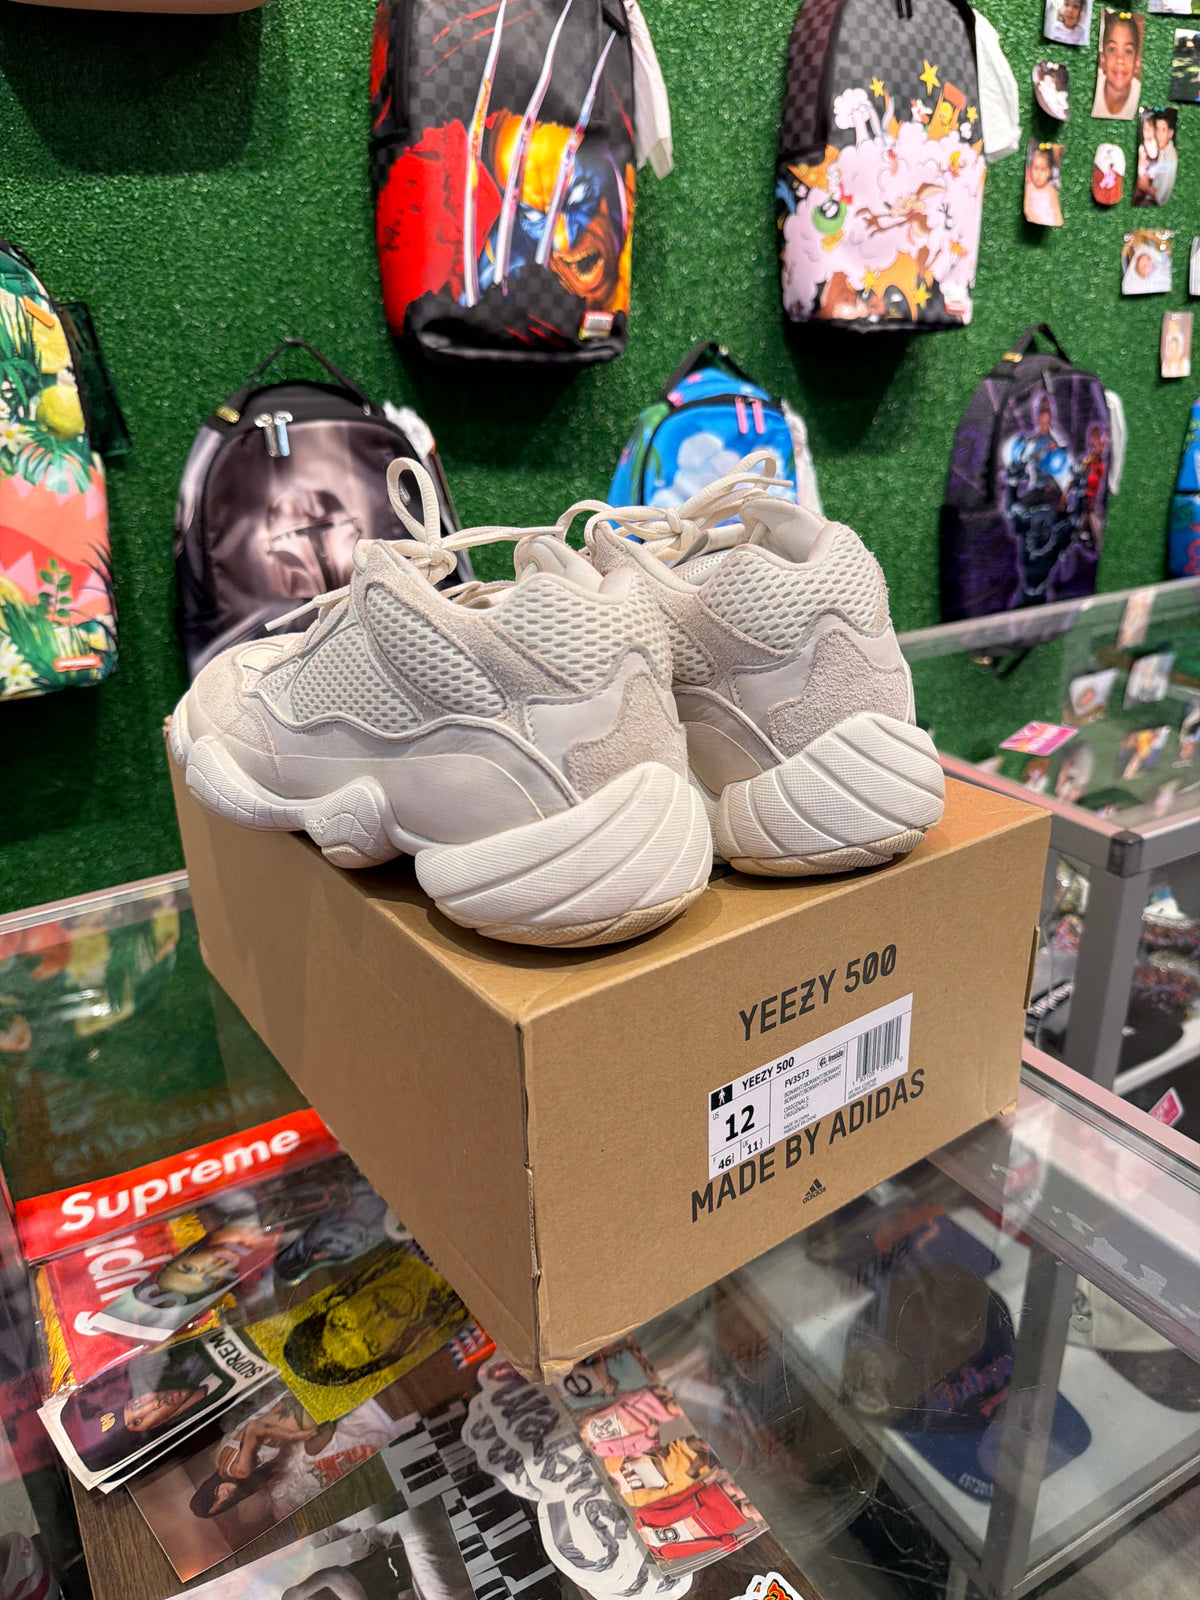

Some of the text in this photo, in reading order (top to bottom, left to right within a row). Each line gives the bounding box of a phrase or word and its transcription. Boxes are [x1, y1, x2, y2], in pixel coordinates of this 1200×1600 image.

[738, 943, 897, 1042] YEEZY 500
[741, 1055, 794, 1091] YEEZY 500
[784, 1068, 810, 1088] FV3573
[712, 1111, 720, 1120] US
[783, 1095, 810, 1113] ORIGINALS
[783, 1102, 810, 1120] ORIGINALS
[725, 1104, 755, 1142] 12
[691, 1068, 925, 1224] MADE BY ADIDAS
[60, 1129, 301, 1231] Supreme
[802, 1185, 827, 1204] adidas
